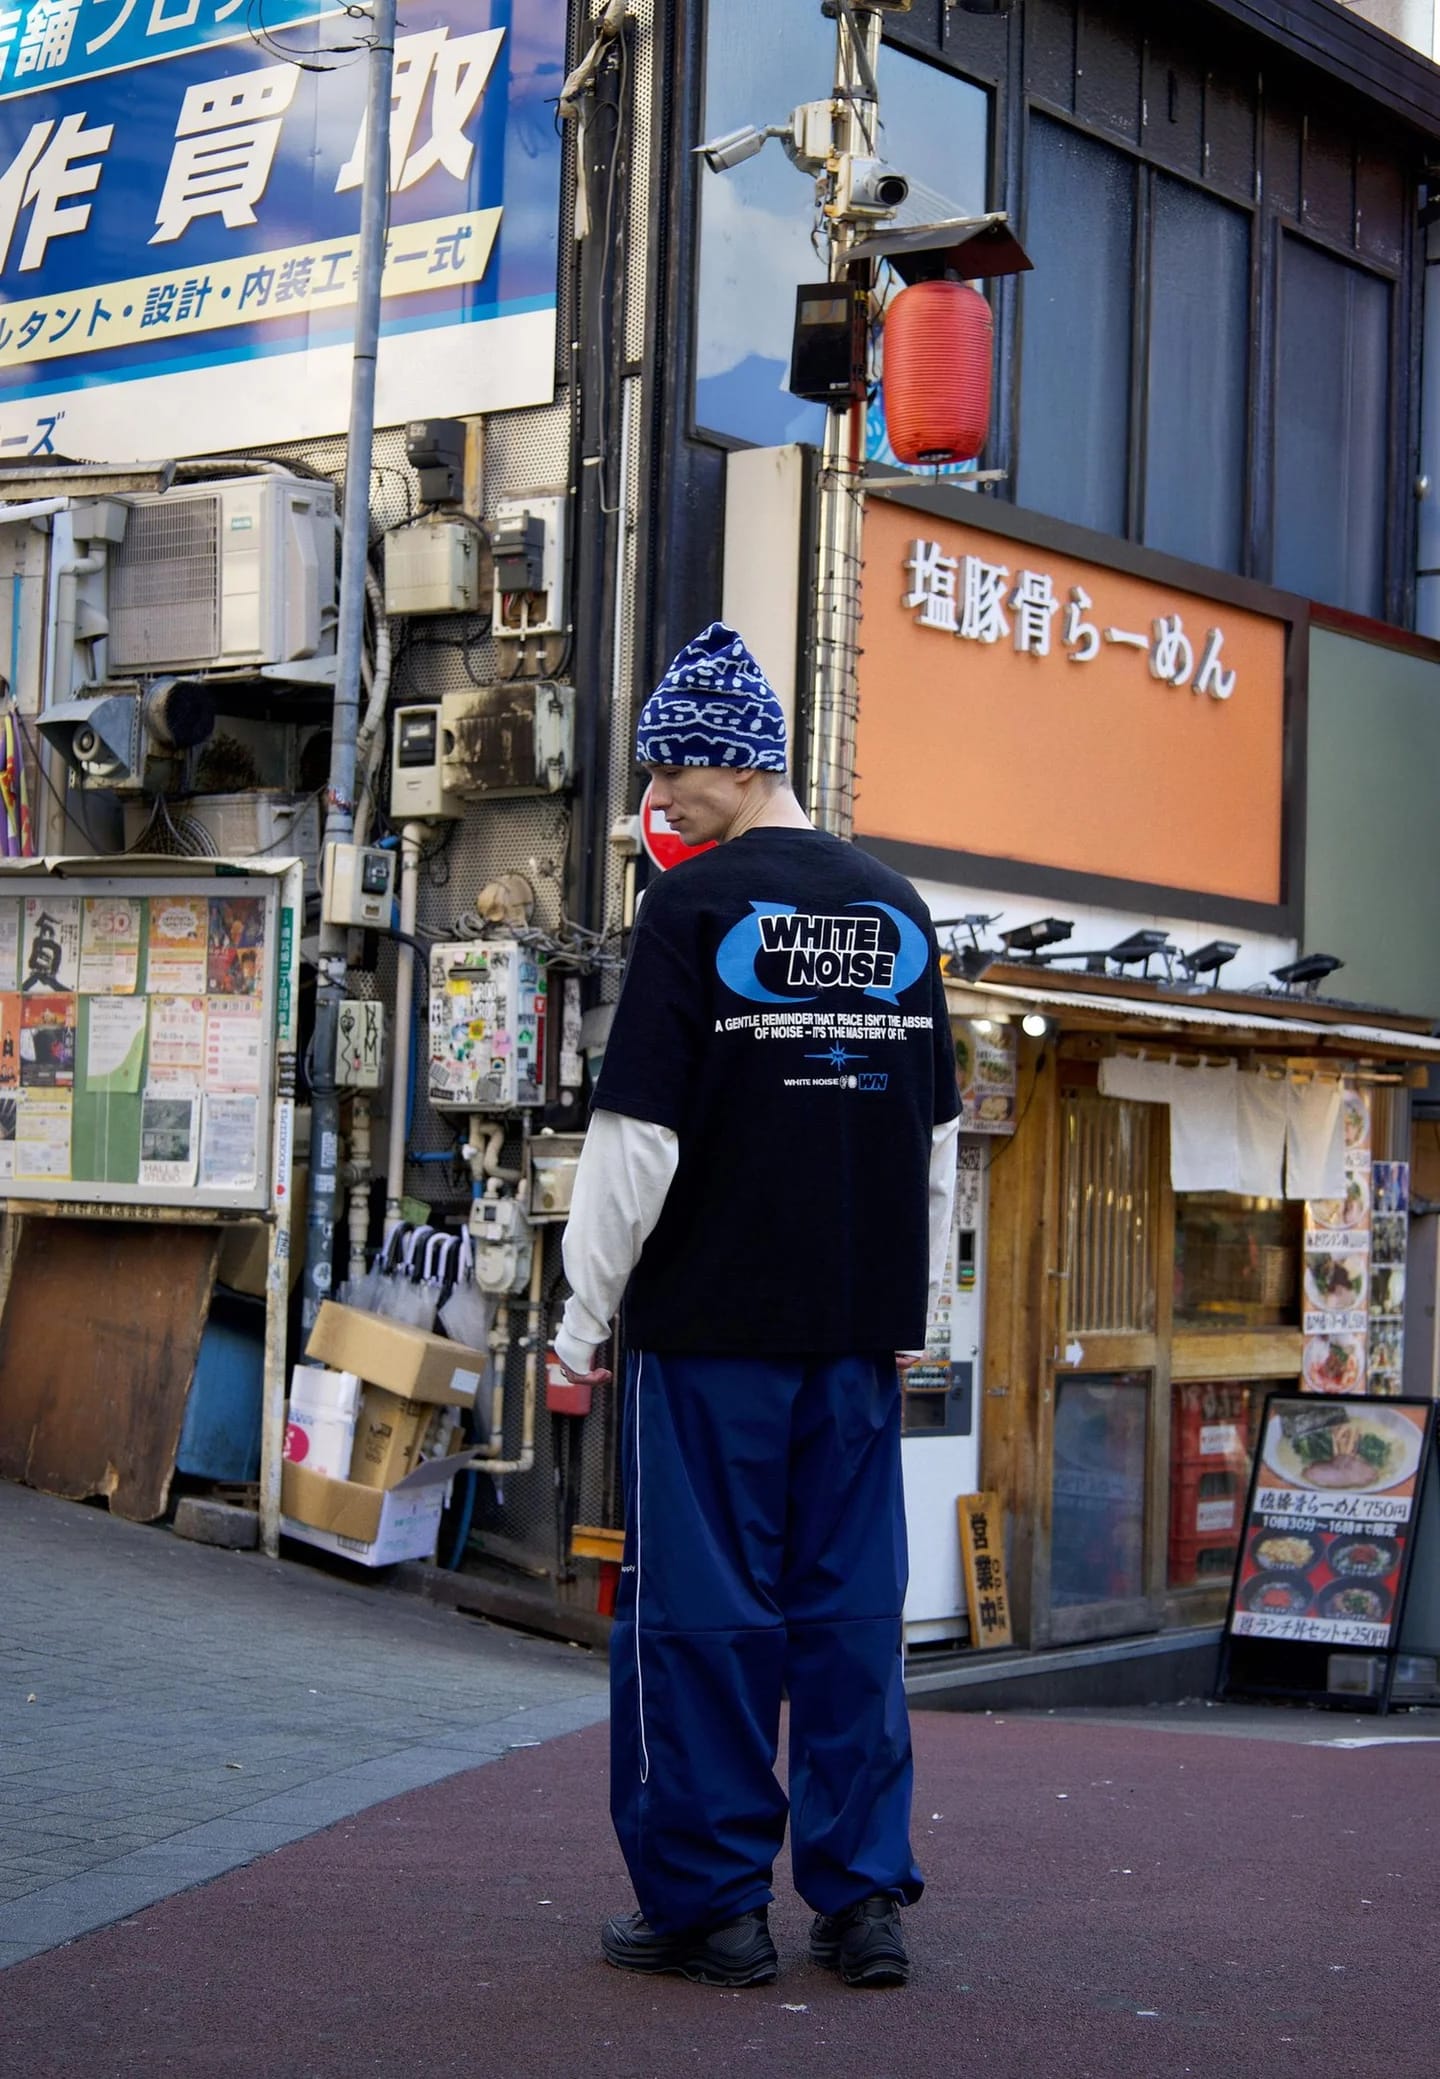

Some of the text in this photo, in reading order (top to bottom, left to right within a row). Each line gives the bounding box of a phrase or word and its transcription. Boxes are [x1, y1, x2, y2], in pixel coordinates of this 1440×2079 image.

[0, 225, 472, 350] ルタント・設計・内装工一式
[903, 538, 1236, 701] 塩豚骨らーめん
[758, 915, 881, 952] WHITE
[786, 950, 896, 988] NOISE
[714, 1019, 724, 1033] A
[725, 1014, 761, 1031] GENTLE
[761, 1012, 814, 1027] REMINDER
[813, 1013, 836, 1026] THAT
[837, 1013, 863, 1027] PEACE
[864, 1014, 887, 1027] ISN'T
[887, 1015, 902, 1028] THE
[754, 1027, 770, 1040] OF
[771, 1026, 804, 1039] NOISE
[812, 1026, 827, 1039] IT'S
[827, 1026, 846, 1039] THE
[846, 1026, 887, 1040] MASTERY
[887, 1028, 897, 1040] OF
[783, 1078, 812, 1086] WHITE
[812, 1078, 840, 1086] NOISE
